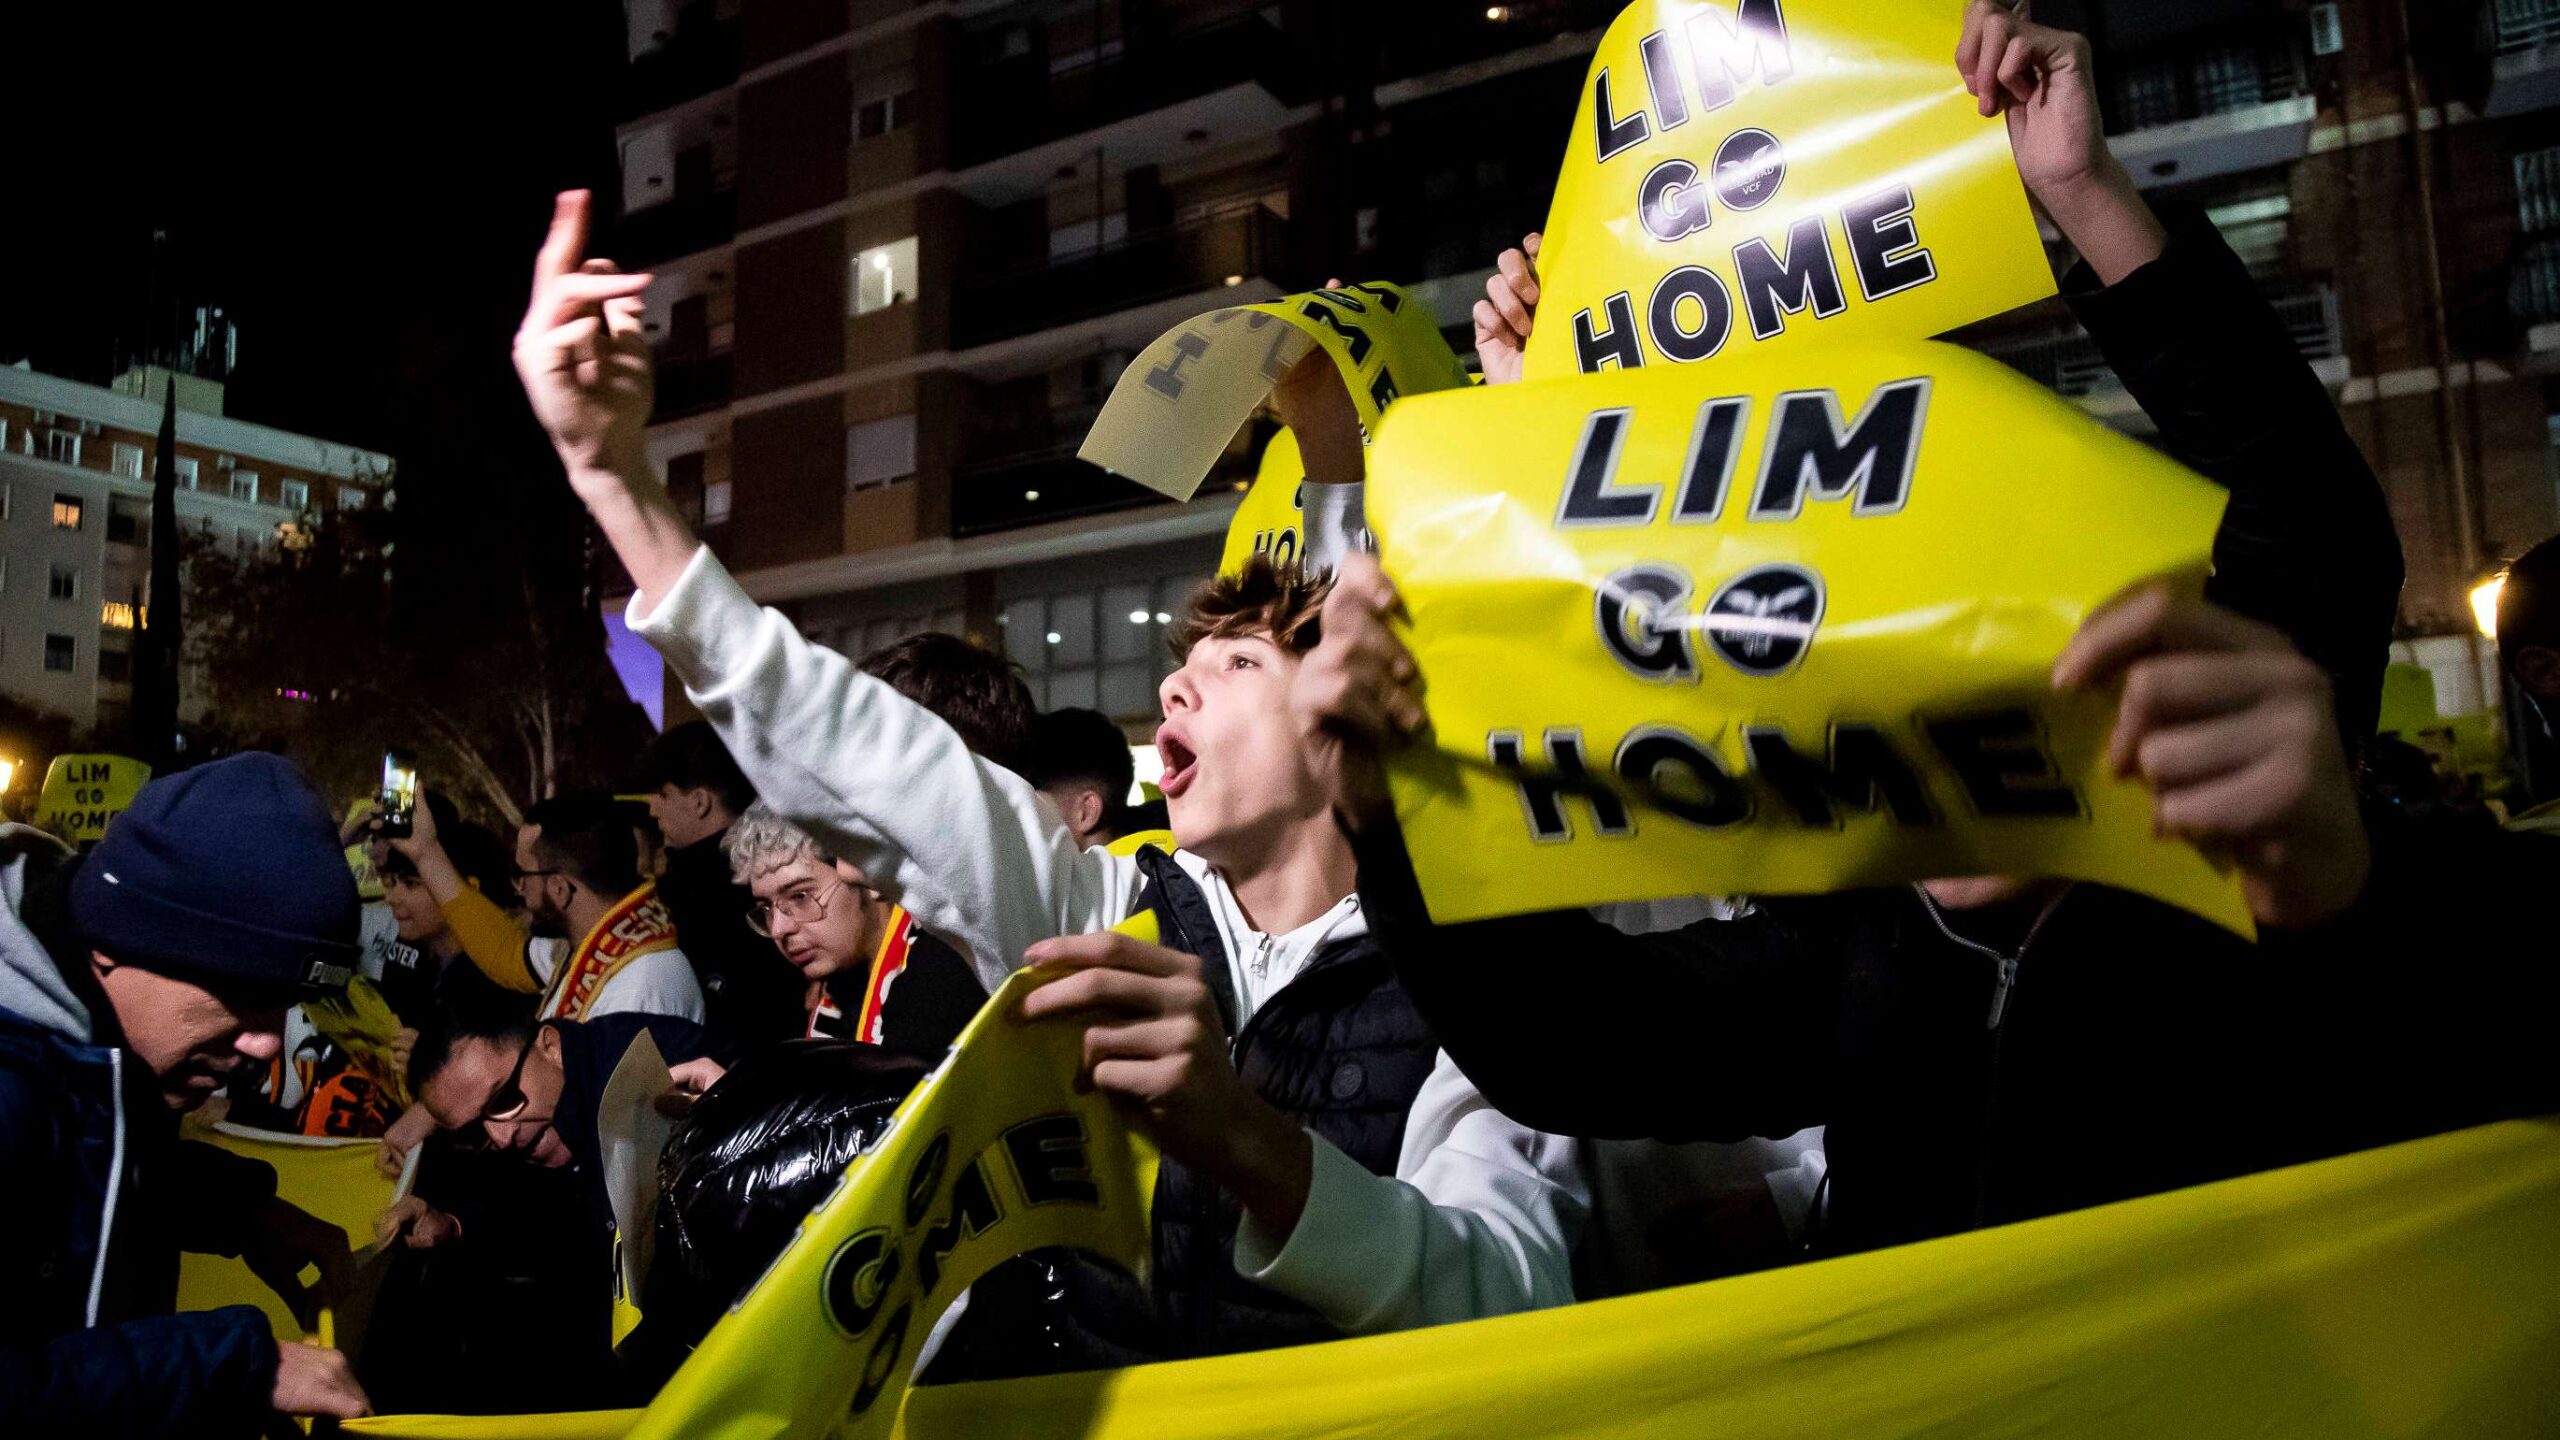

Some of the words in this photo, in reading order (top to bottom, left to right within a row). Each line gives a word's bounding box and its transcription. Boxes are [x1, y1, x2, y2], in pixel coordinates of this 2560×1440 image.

[1594, 0, 1793, 164] LIM
[1637, 127, 1786, 242] GO
[1742, 181, 1762, 195] VCF
[1571, 183, 1937, 374] HOME
[1552, 376, 1934, 529] LIM
[1593, 562, 1827, 685] GO
[66, 763, 111, 782] LIM
[75, 788, 104, 805] GO
[1486, 708, 2091, 843] HOME
